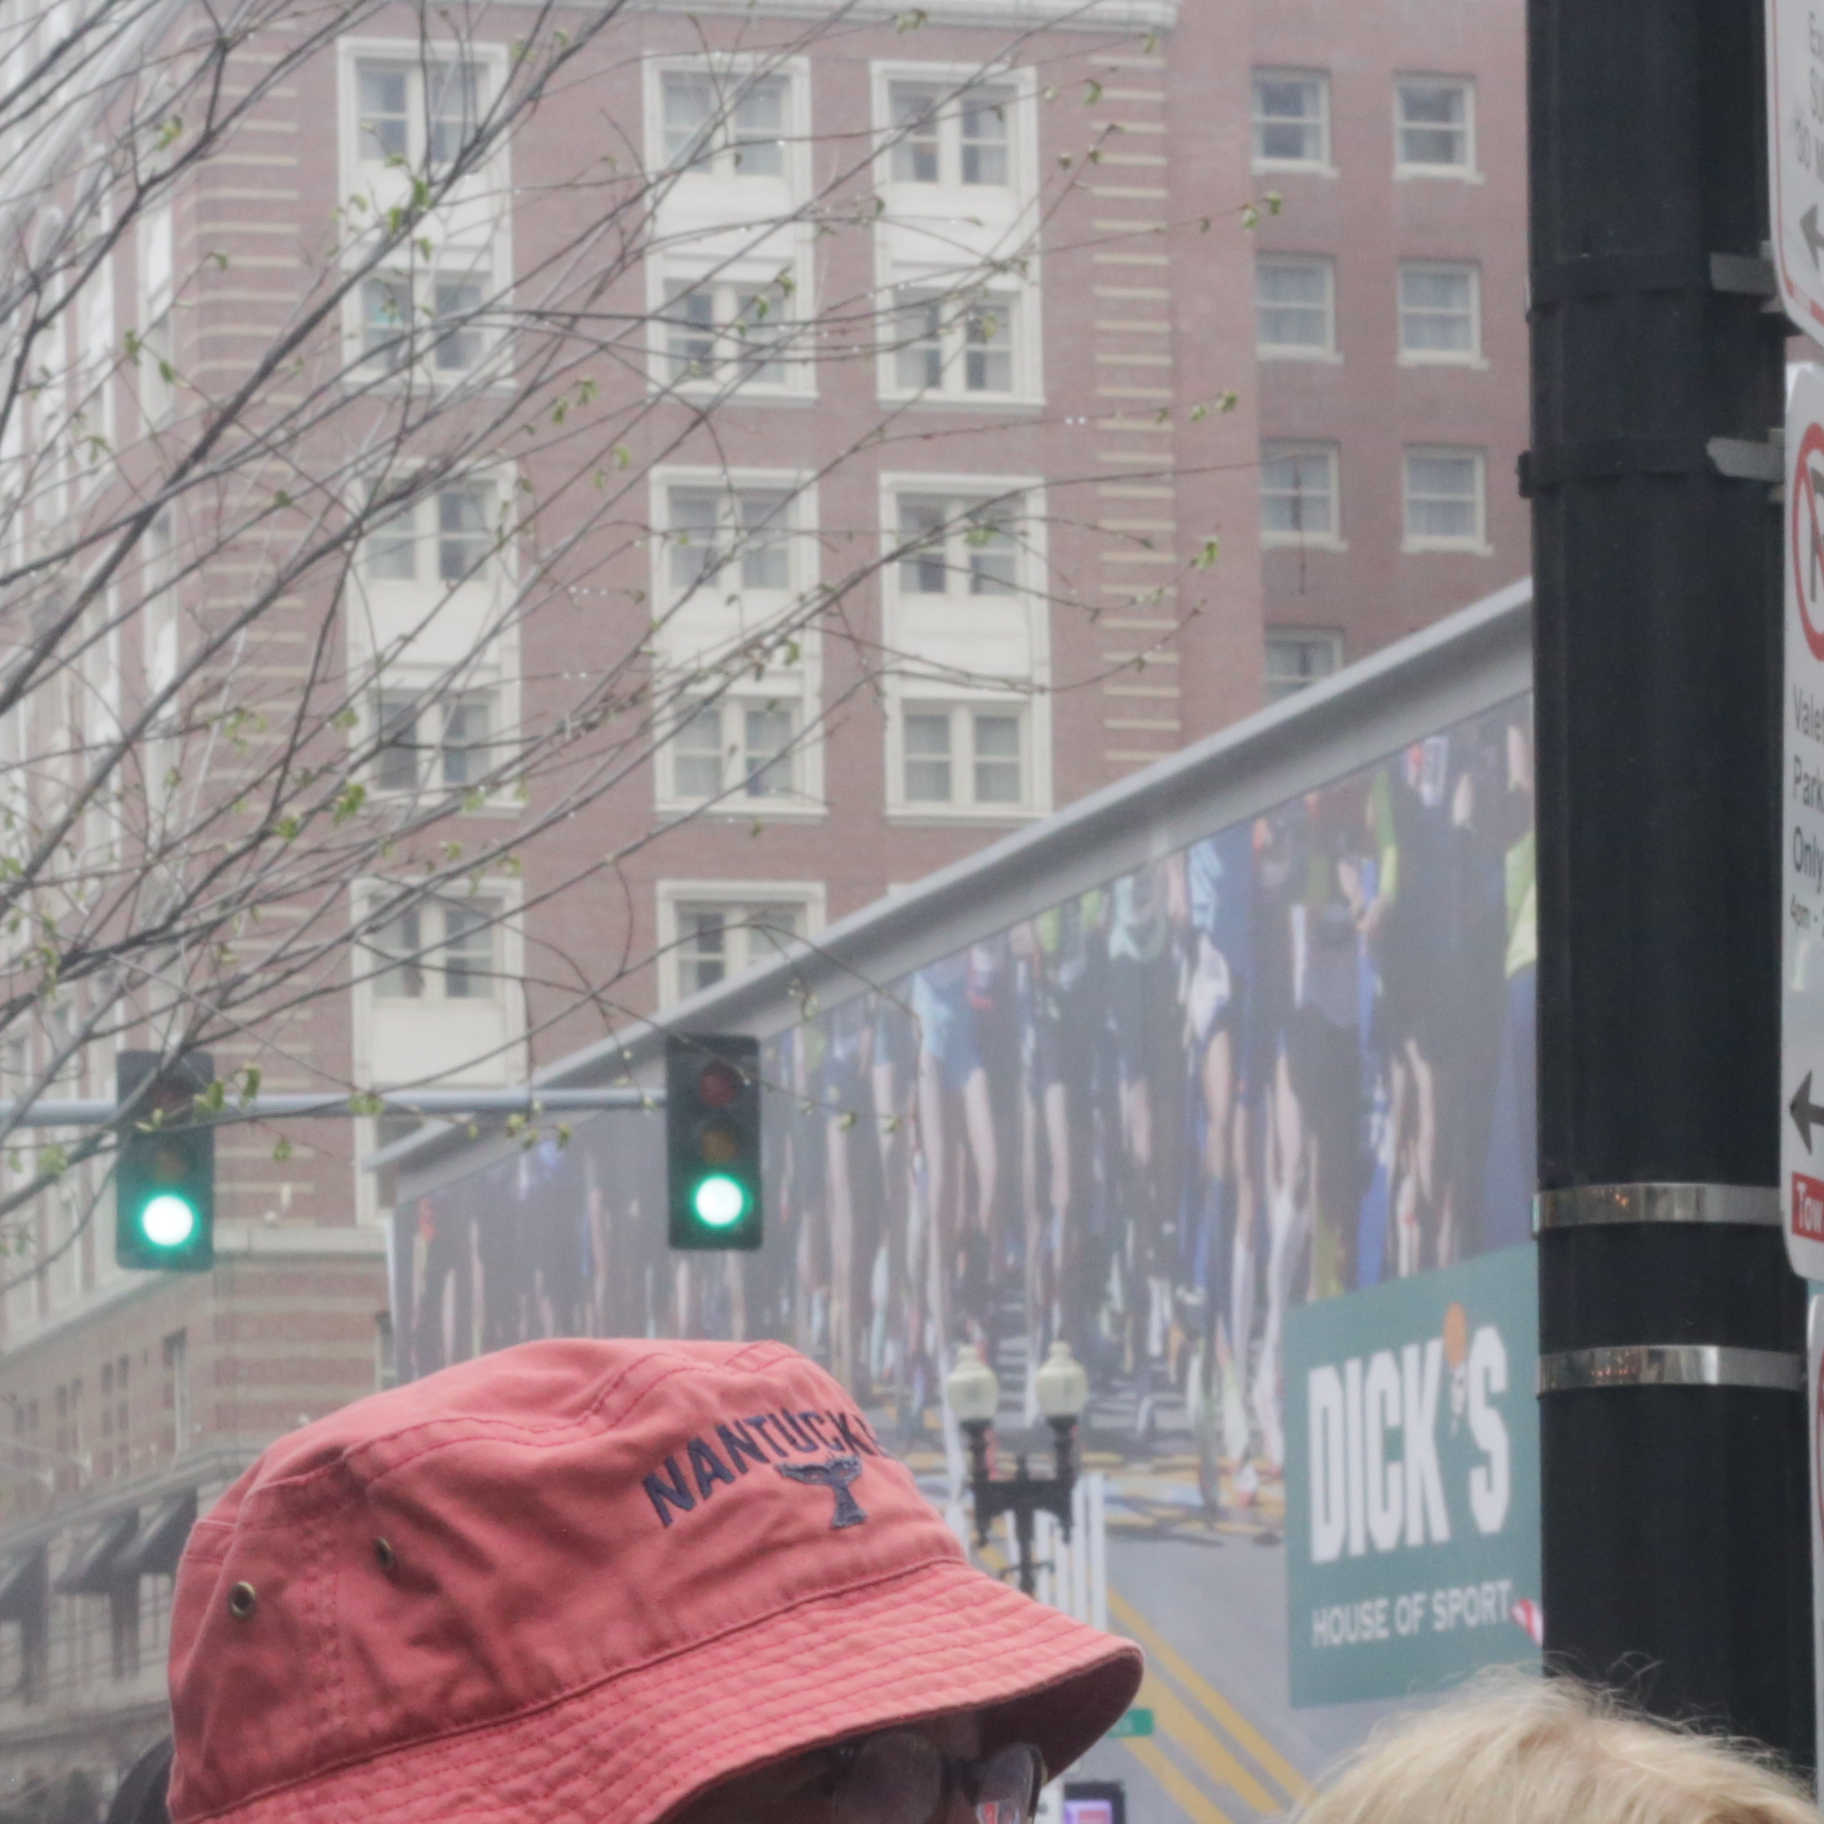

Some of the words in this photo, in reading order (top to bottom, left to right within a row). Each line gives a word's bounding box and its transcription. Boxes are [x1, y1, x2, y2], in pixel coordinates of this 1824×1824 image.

[1792, 825, 1824, 895] Only
[1796, 1181, 1824, 1234] Tow
[642, 1404, 893, 1529] NANTUCK
[1308, 1304, 1512, 1565] DICK'S
[1312, 1597, 1391, 1648] HOUSE
[1393, 1592, 1428, 1637] OF
[1432, 1579, 1513, 1633] SPORT
